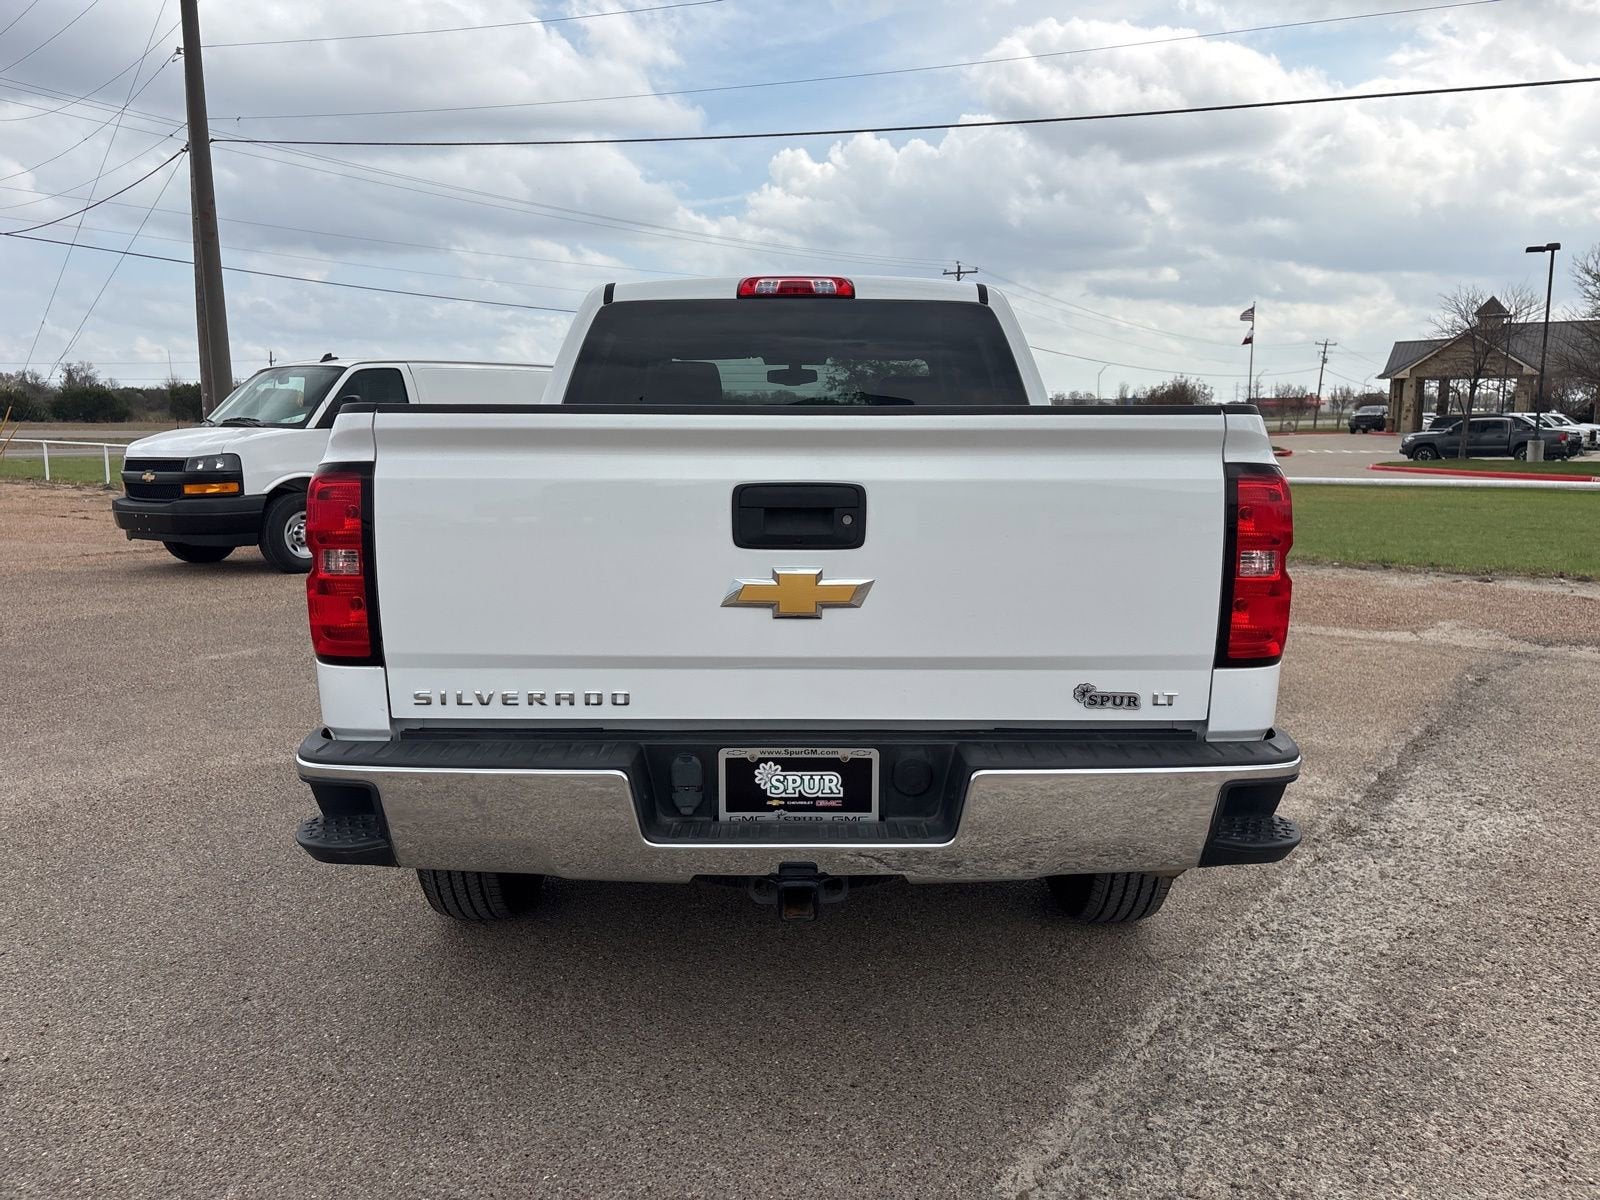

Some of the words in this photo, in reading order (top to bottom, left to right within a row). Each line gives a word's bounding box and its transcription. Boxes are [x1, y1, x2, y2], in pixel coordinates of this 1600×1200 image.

[413, 690, 630, 706] SILVERADO
[1152, 692, 1179, 706] LT
[759, 748, 839, 757] www.SpurGM.com
[768, 774, 842, 796] SPUR
